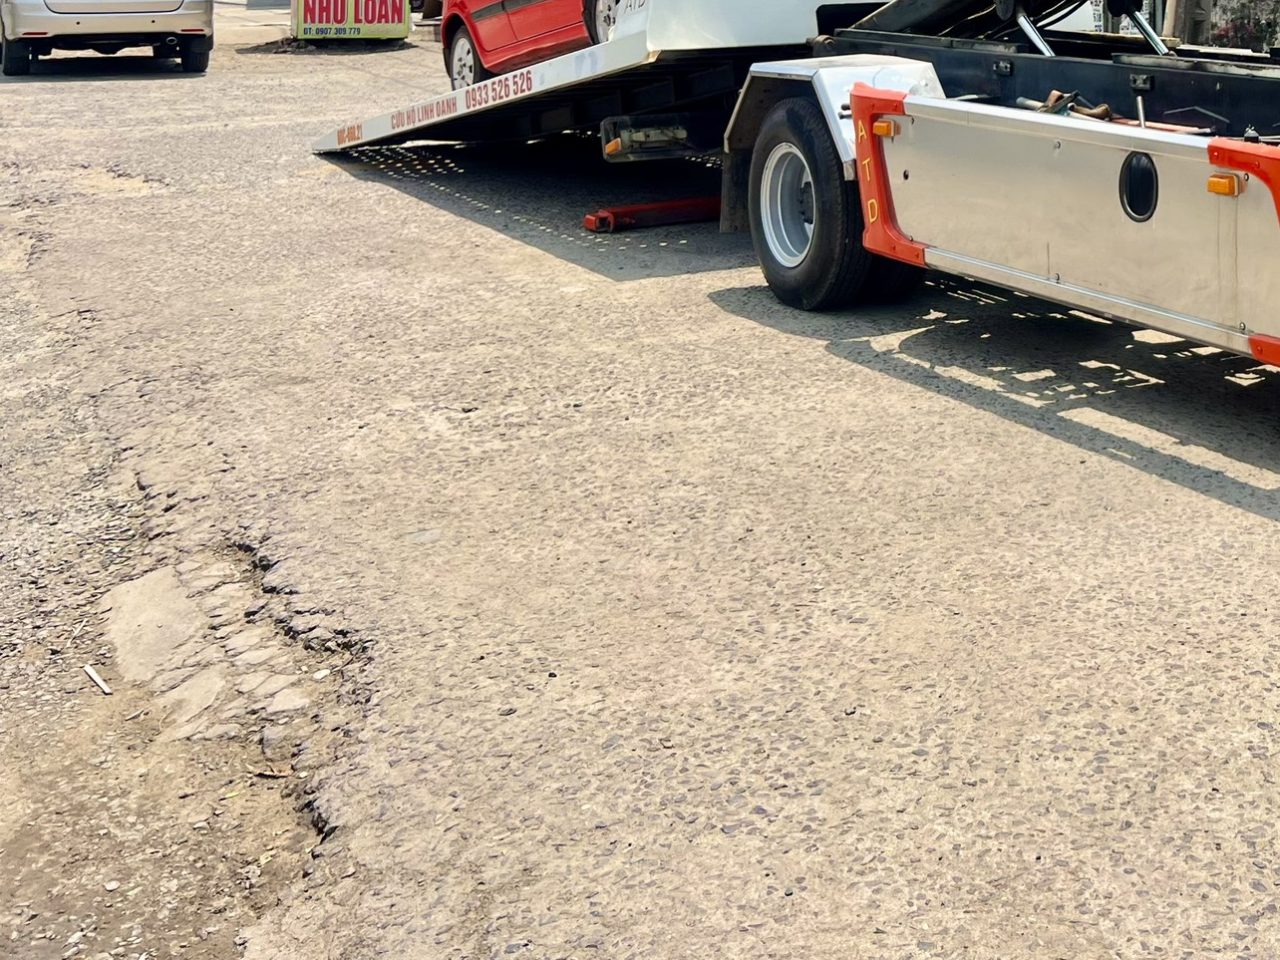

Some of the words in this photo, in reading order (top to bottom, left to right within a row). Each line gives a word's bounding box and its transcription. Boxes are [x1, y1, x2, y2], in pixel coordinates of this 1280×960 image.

[465, 85, 490, 110] 0933
[491, 77, 510, 102] 526
[512, 70, 533, 97] 526
